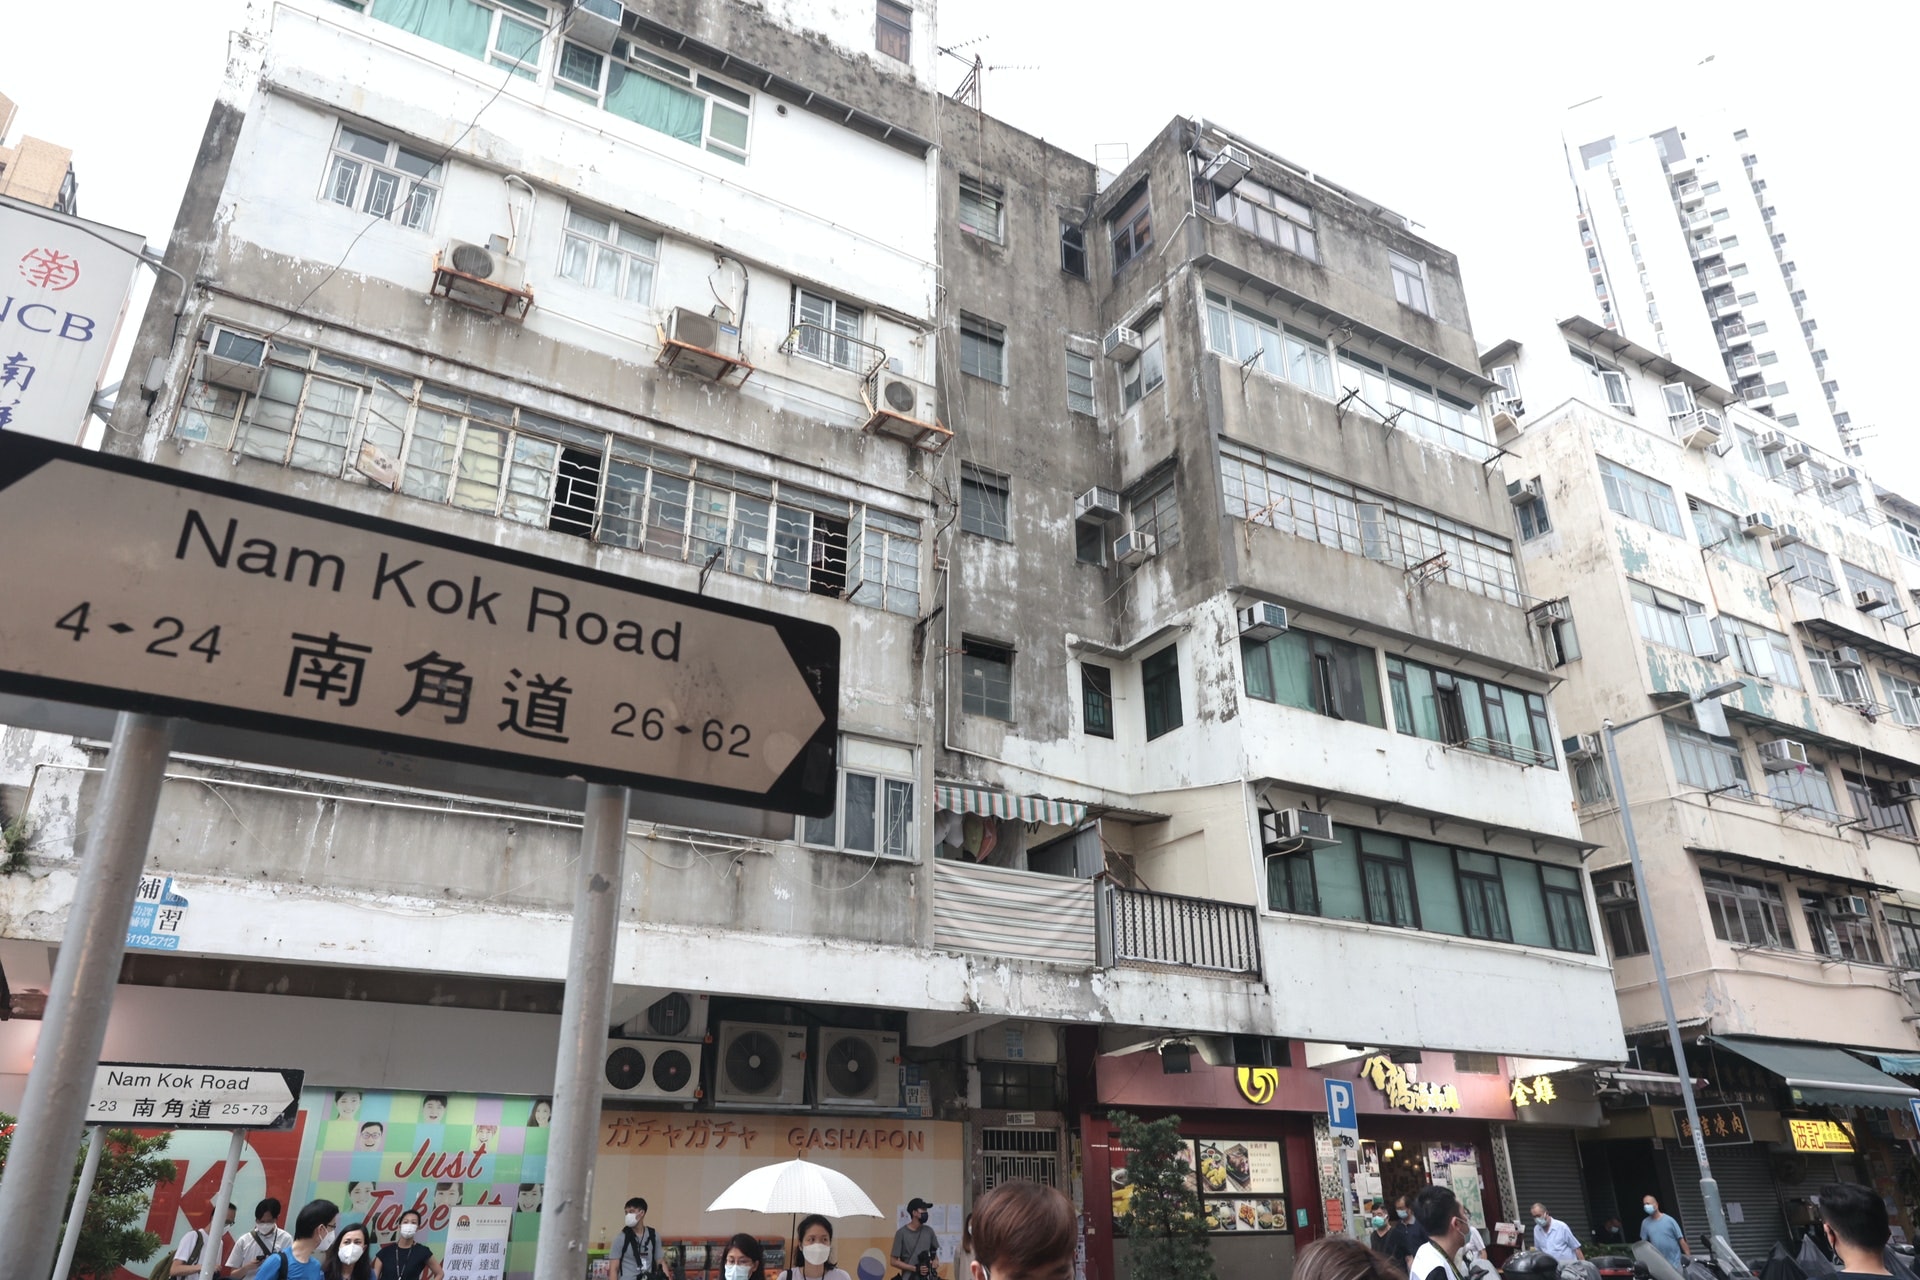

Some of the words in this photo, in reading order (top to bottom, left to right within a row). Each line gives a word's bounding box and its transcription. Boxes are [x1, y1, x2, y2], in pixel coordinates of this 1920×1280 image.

[174, 509, 346, 591] Nam
[373, 552, 501, 625] Kok
[526, 586, 684, 663] Road
[282, 632, 574, 745] 南角道
[159, 909, 182, 931] 習
[107, 1071, 151, 1087] Nam
[157, 1073, 195, 1089] Kok
[200, 1074, 250, 1090] Road
[132, 1097, 213, 1119] 南角道
[1330, 1085, 1349, 1123] P
[606, 1115, 758, 1150] ガチャガチャ
[786, 1126, 925, 1152] GASHAPON
[1792, 1121, 1825, 1149] 波記
[394, 1138, 487, 1179] Just
[362, 1188, 450, 1231] Take
